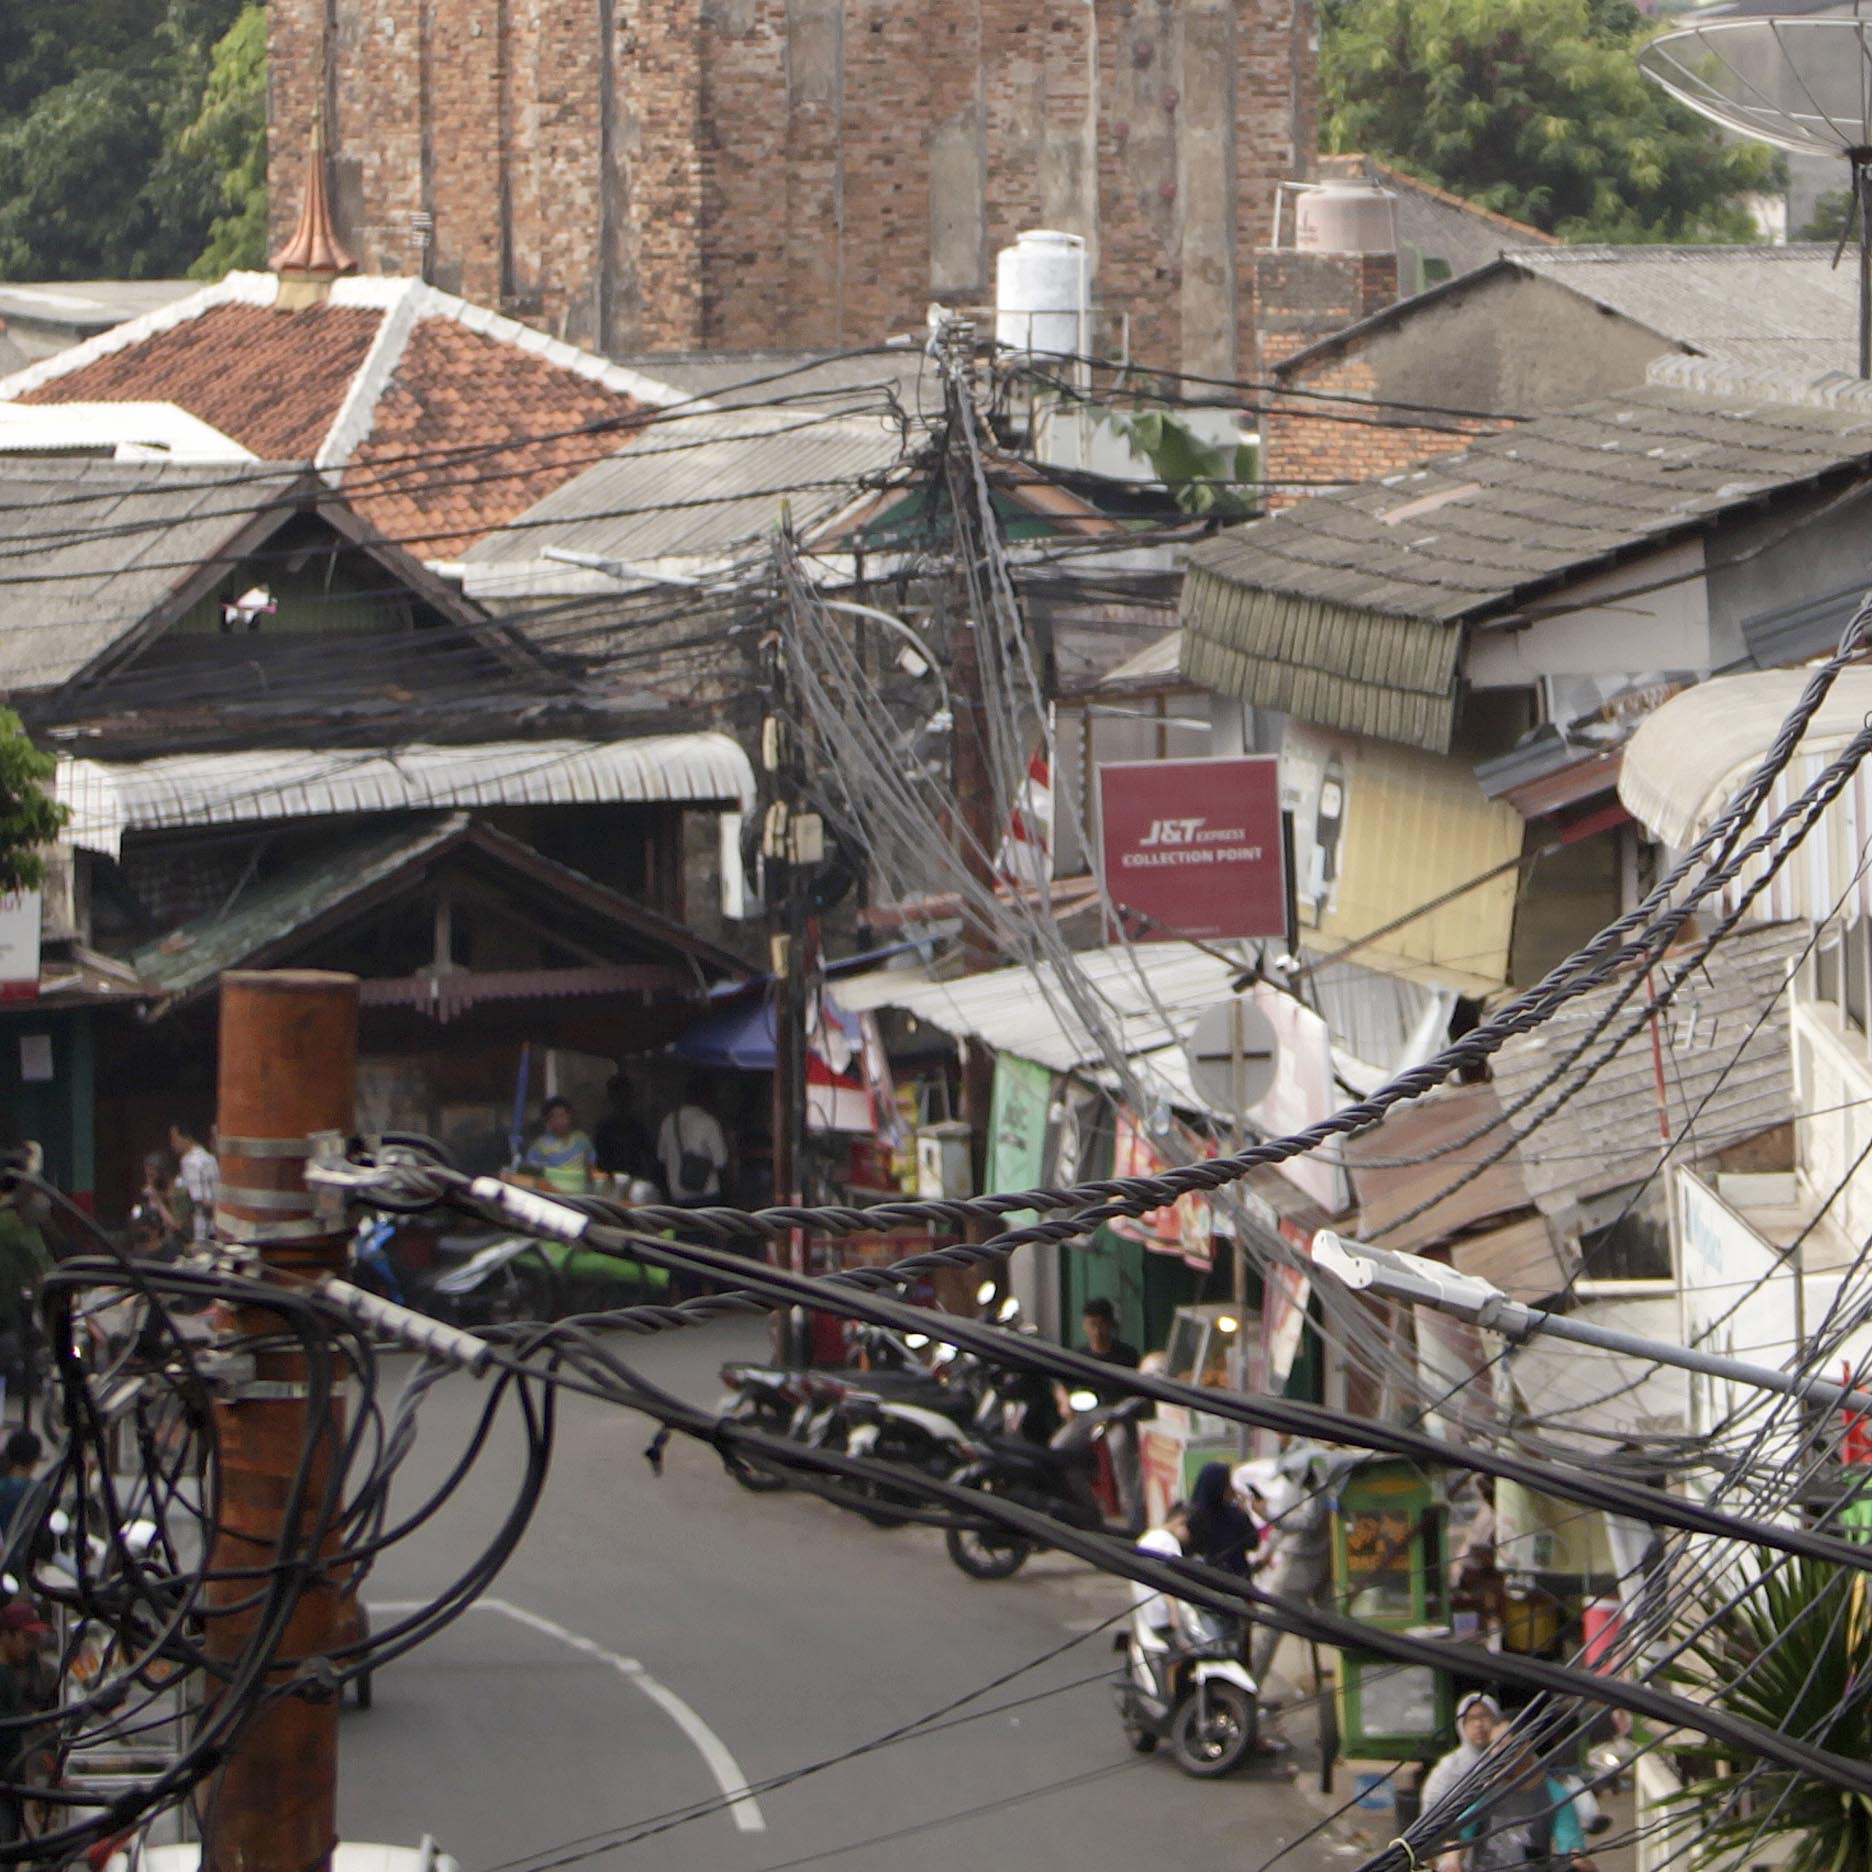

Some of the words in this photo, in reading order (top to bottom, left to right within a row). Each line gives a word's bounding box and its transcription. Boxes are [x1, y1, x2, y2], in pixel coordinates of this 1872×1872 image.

[1140, 819, 1205, 845] J&T
[1196, 830, 1245, 841] EXPRESS
[1122, 850, 1213, 866] COLLECTION
[1217, 847, 1262, 861] POINT
